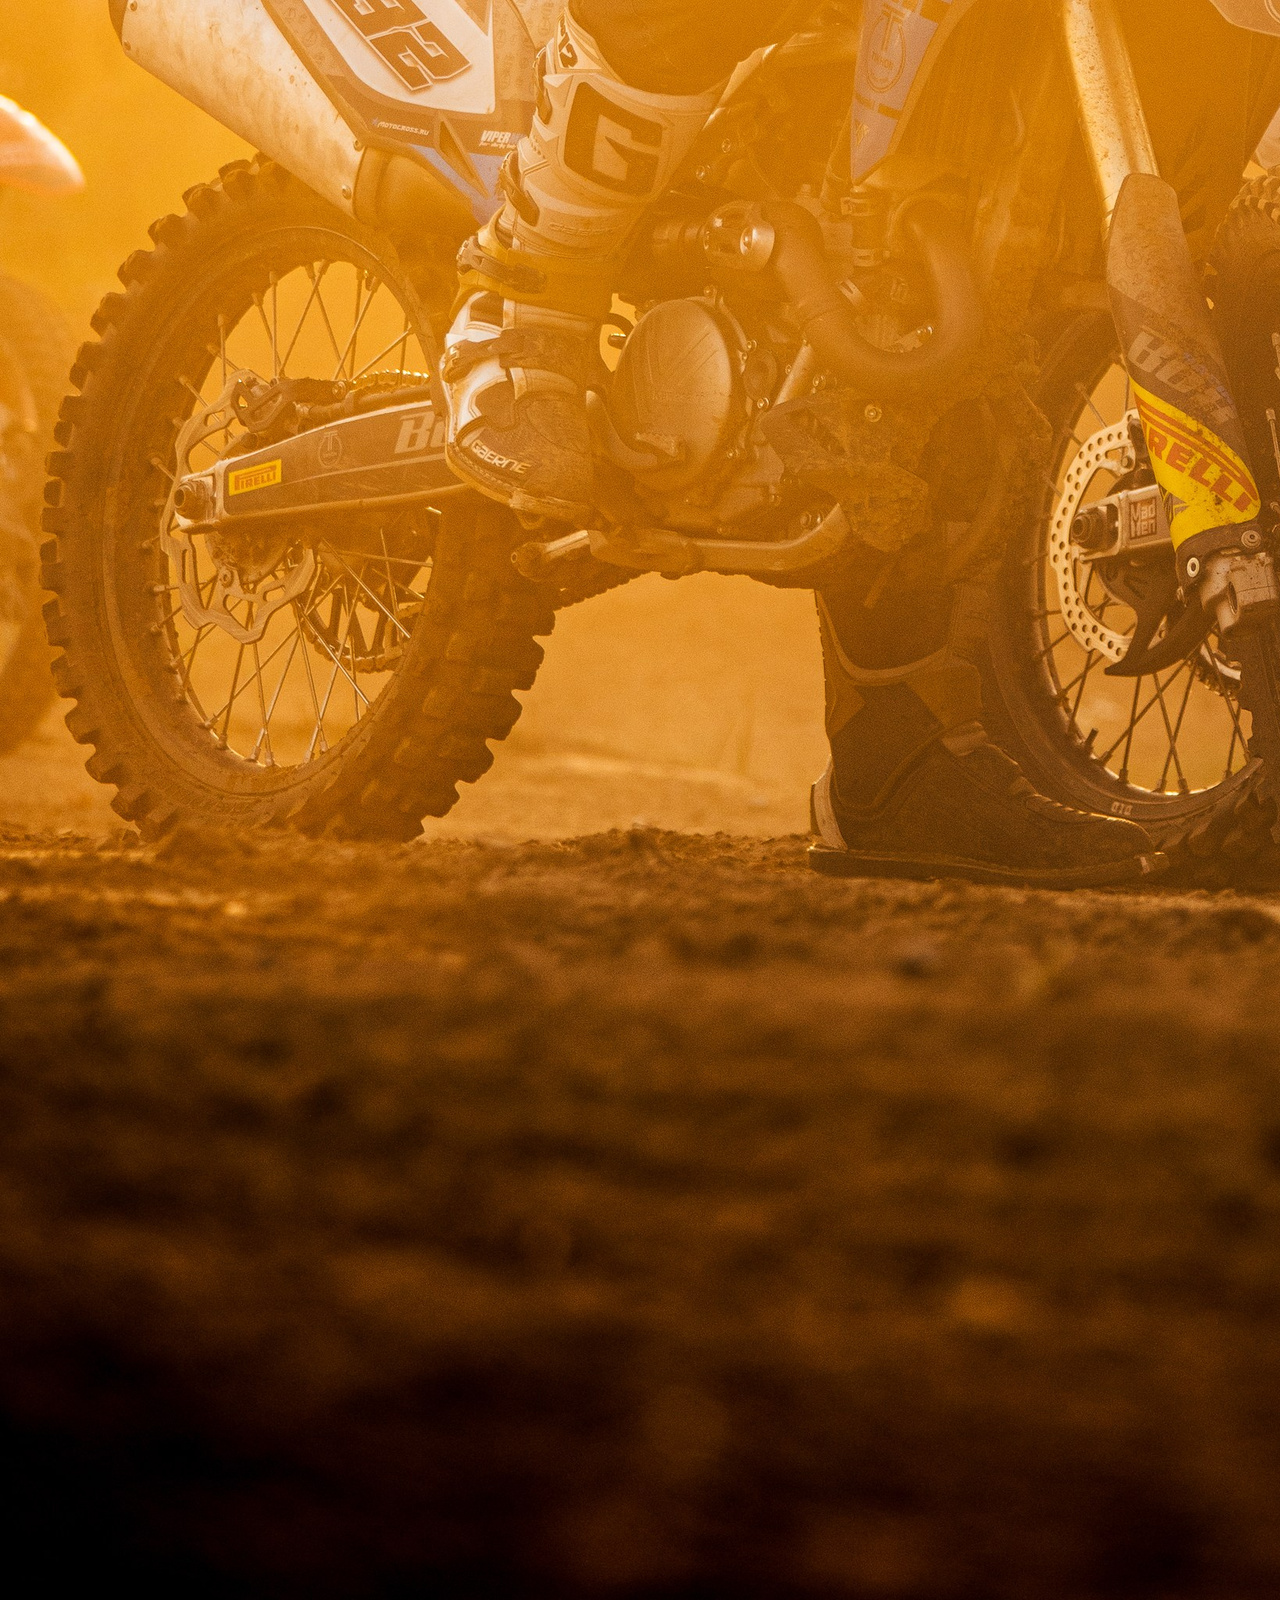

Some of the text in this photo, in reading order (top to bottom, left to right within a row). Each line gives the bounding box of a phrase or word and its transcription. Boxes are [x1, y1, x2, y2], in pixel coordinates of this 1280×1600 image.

[480, 129, 511, 144] VIPER
[234, 465, 277, 492] PIRELLI
[1131, 499, 1156, 520] Mad
